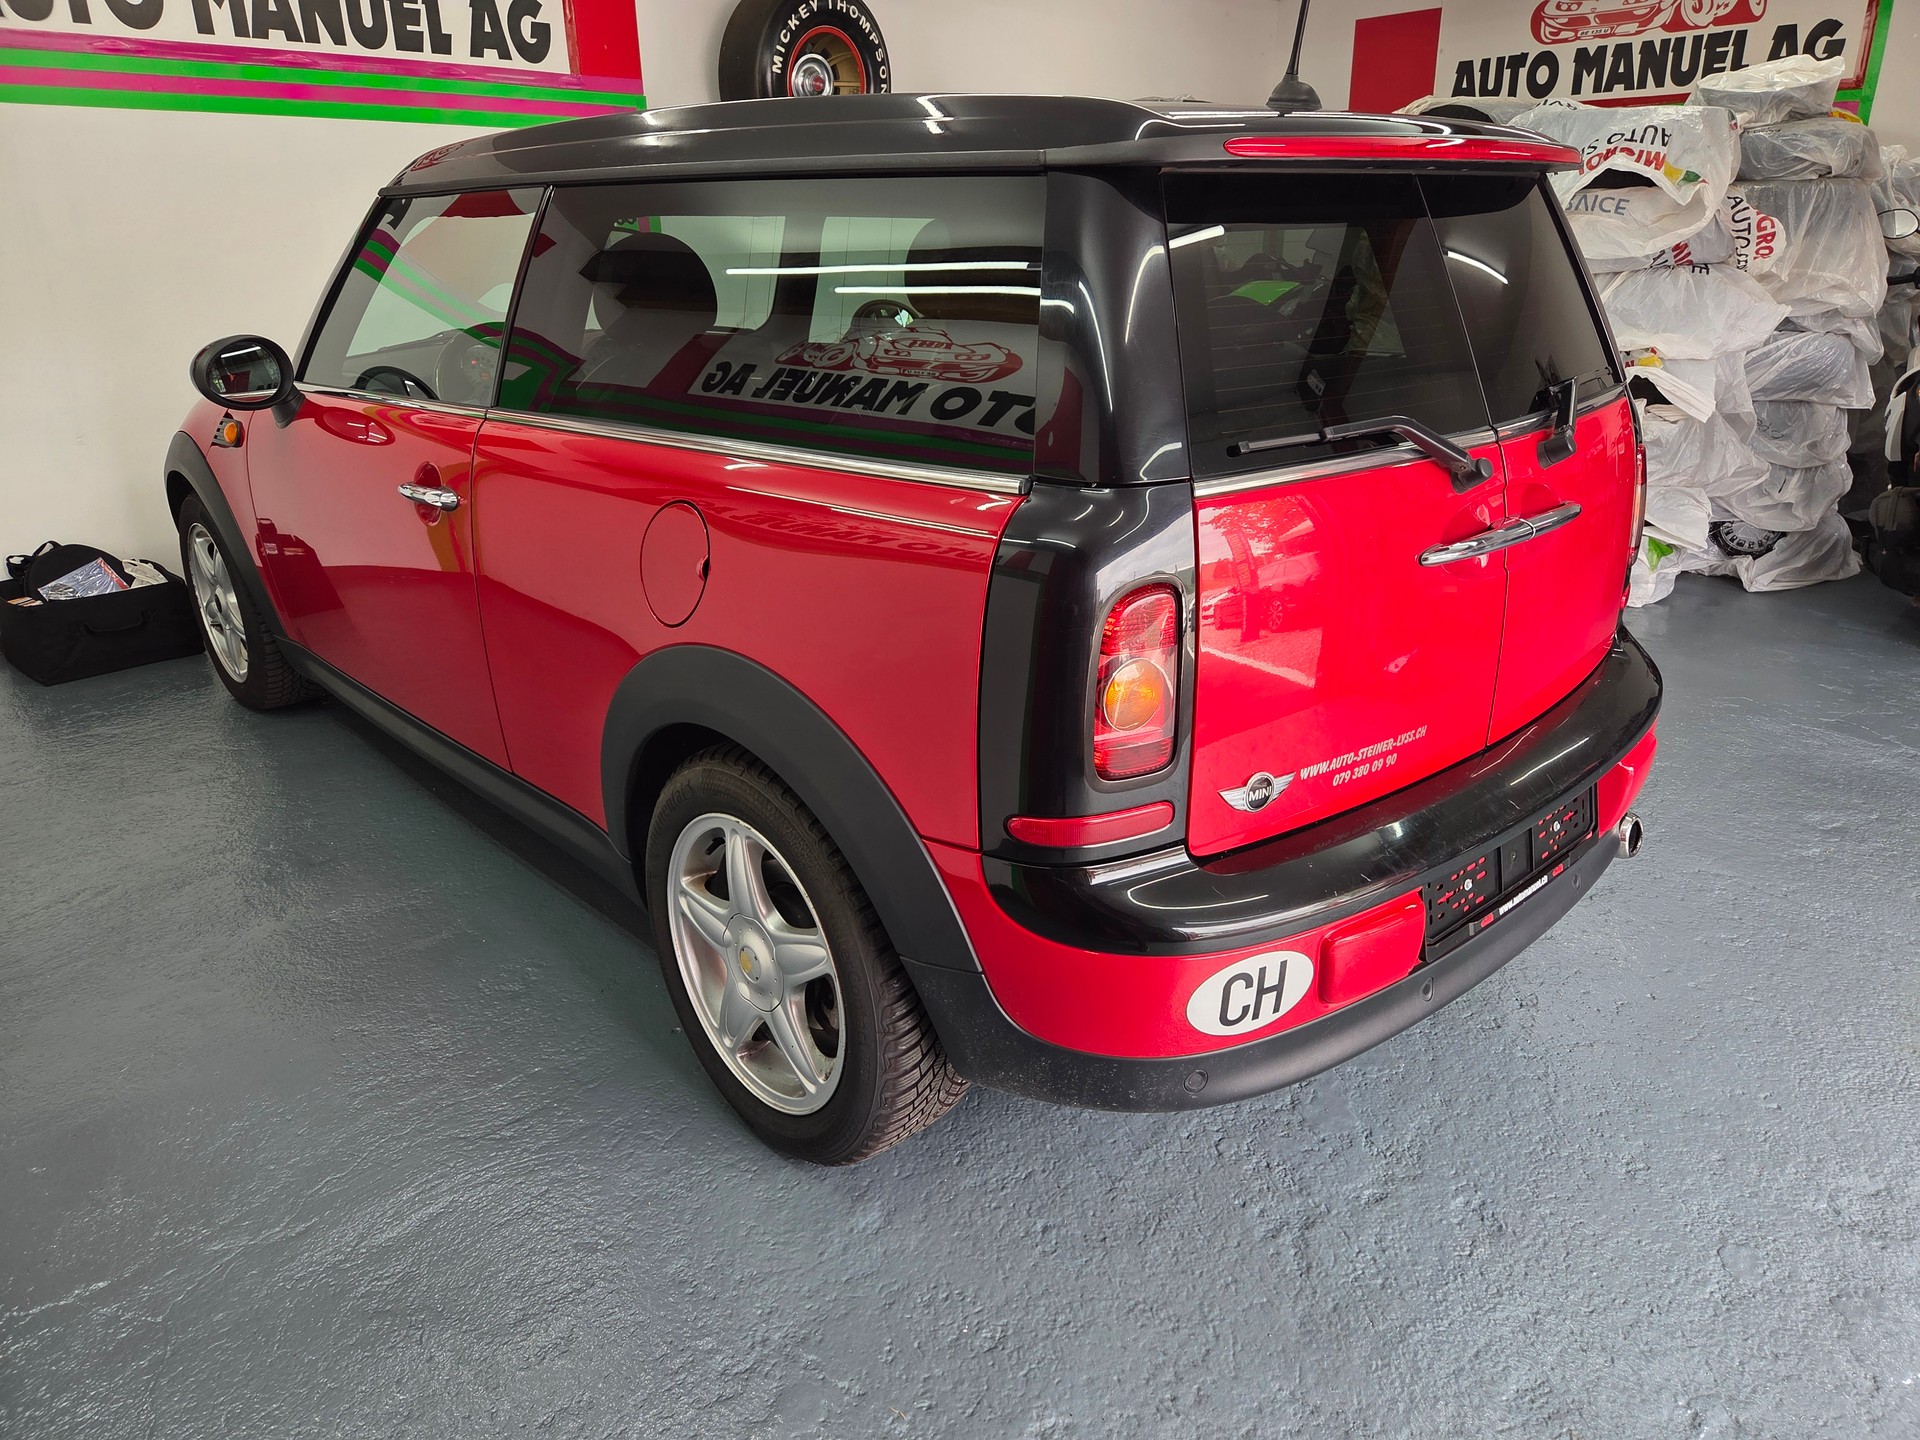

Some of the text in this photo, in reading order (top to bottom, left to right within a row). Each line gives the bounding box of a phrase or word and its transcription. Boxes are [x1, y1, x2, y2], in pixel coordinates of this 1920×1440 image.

[469, 0, 551, 64] AG
[772, 0, 818, 74] MICKEY
[1451, 18, 1847, 99] AUTO MANUEL AG
[1606, 124, 1672, 148] AUTO
[1753, 209, 1777, 261] GRO
[1300, 725, 1428, 780] WWW.AUTO-STEINER-LYSS.CH
[1332, 753, 1398, 788] 079 380 09 90
[1249, 785, 1273, 802] MINI
[1218, 960, 1288, 1028] CH
